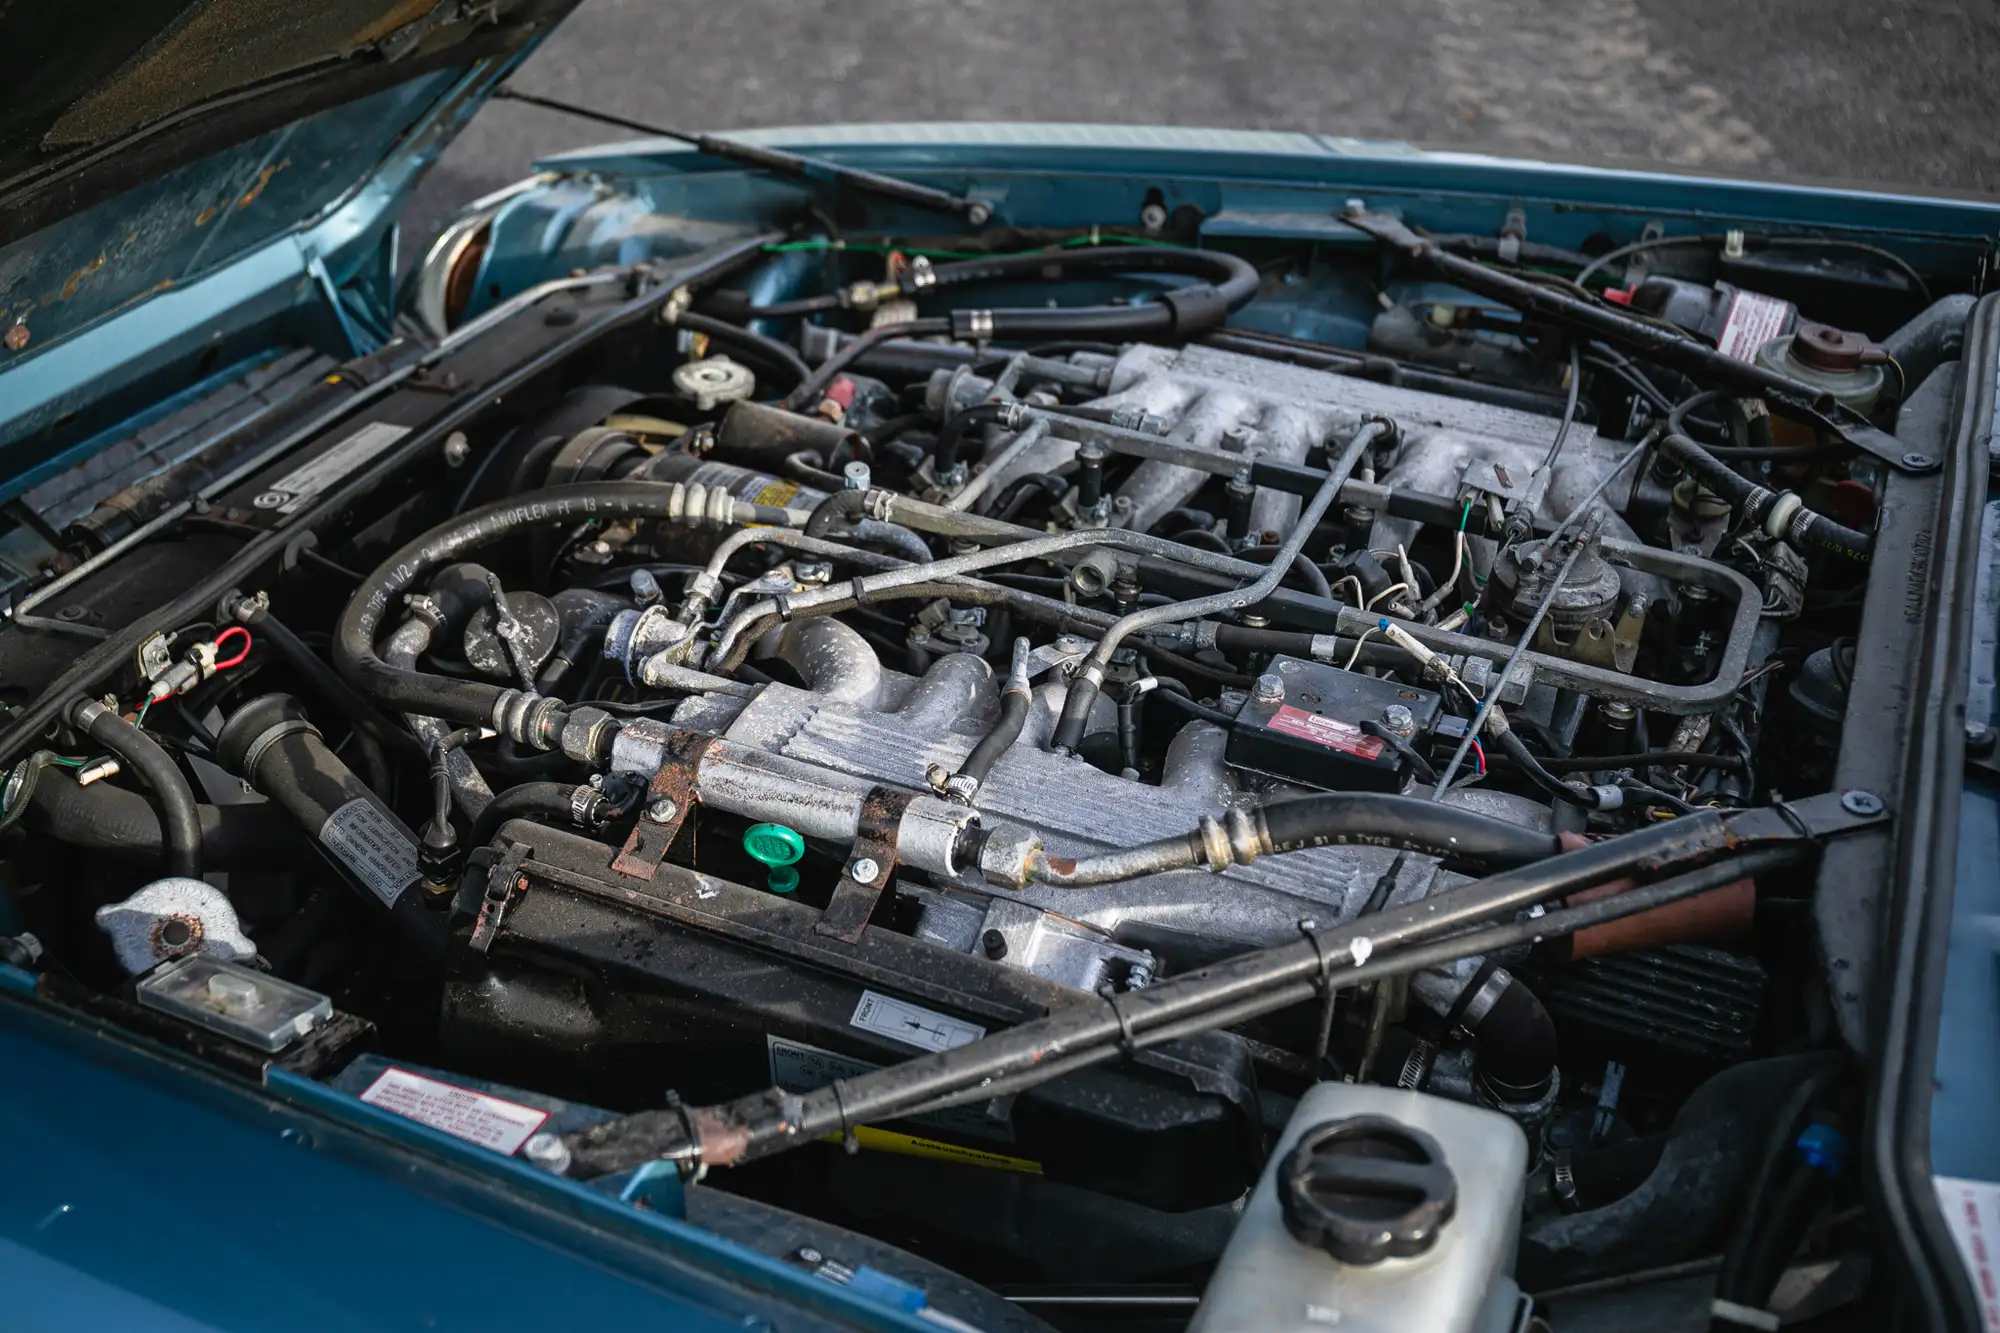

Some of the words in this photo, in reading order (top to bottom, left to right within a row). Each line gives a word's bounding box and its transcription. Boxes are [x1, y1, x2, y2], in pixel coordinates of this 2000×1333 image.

[558, 500, 571, 514] FF
[584, 497, 596, 512] 13
[367, 590, 387, 612] TYPE
[385, 582, 395, 592] A
[332, 807, 358, 828] TEXACO
[349, 823, 382, 853] INFORMATION
[383, 854, 401, 870] REFER
[354, 814, 367, 824] FOR
[368, 826, 400, 854] LUBRICATION
[402, 857, 414, 867] AND
[1357, 834, 1390, 846] TYPE
[337, 826, 345, 834] TO
[346, 835, 368, 856] OWNERS
[369, 856, 397, 881] HANDBOOK
[368, 873, 383, 887] ESSO
[859, 998, 873, 1022] FRONT
[776, 1047, 805, 1060] FRONT
